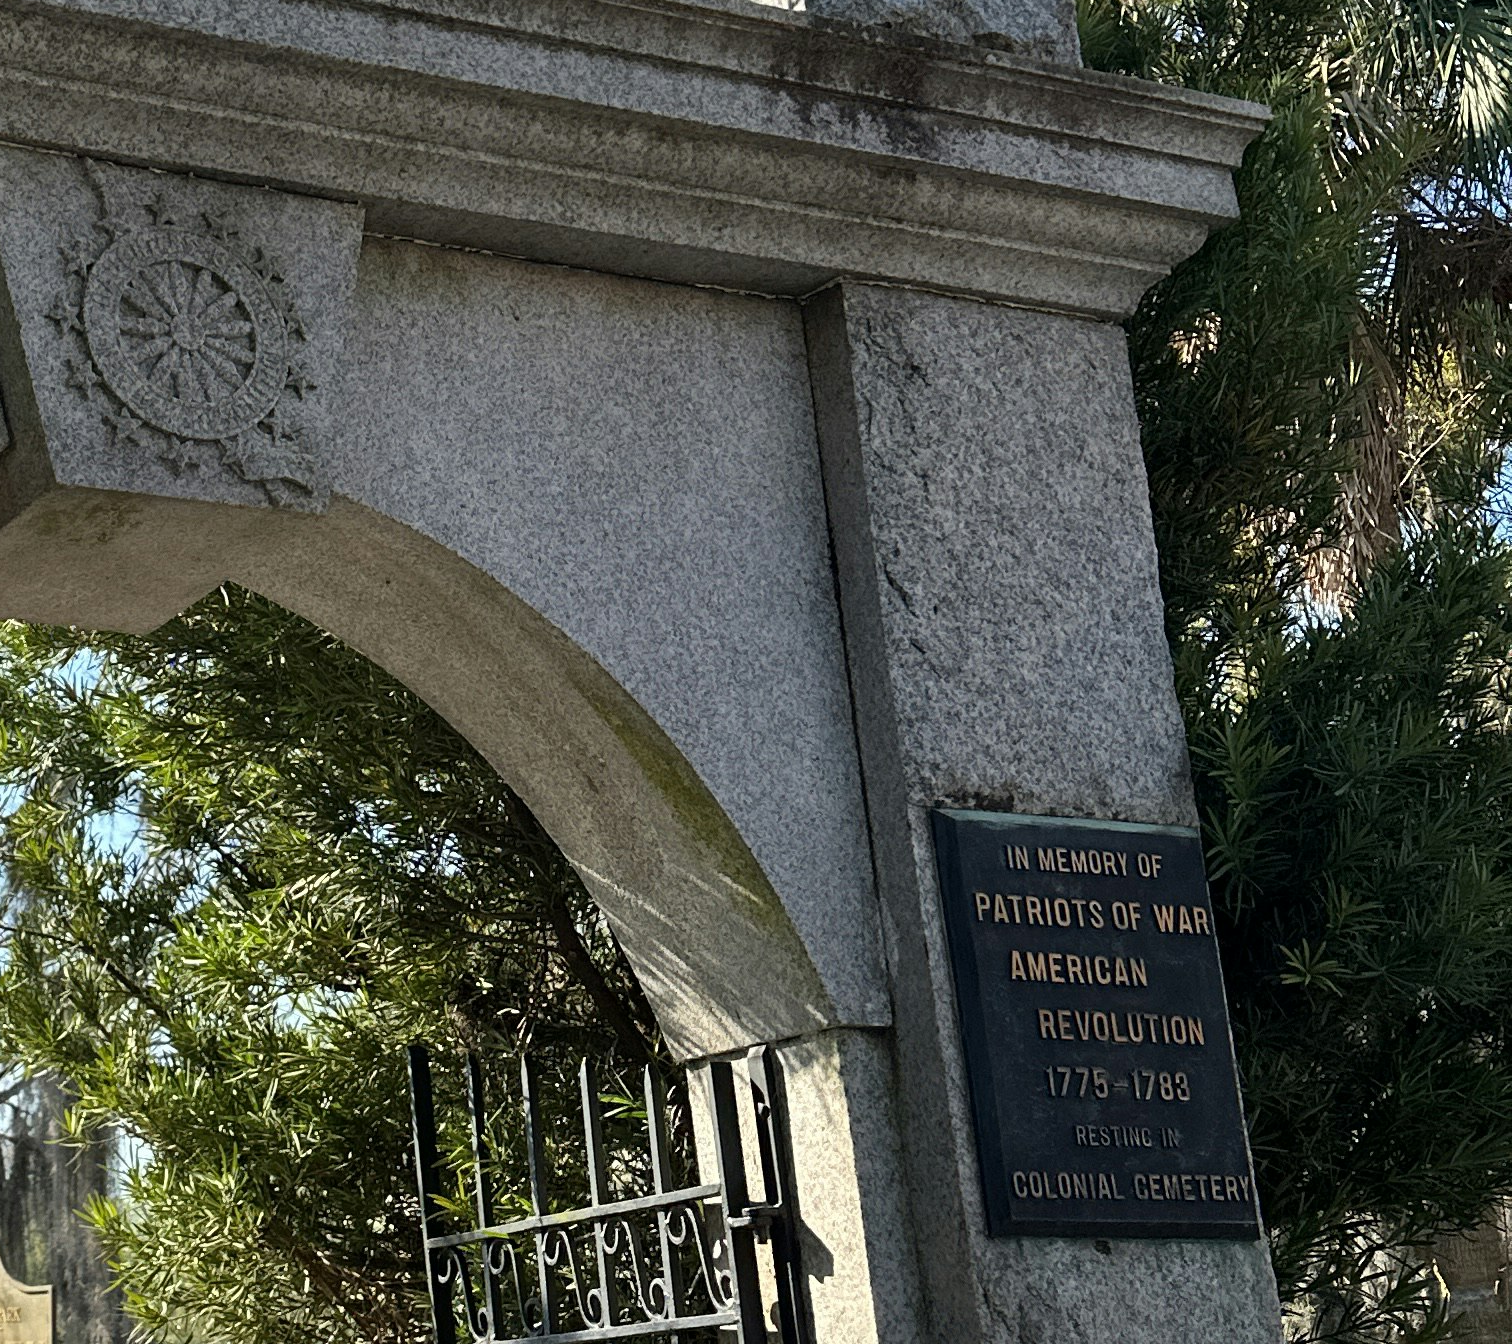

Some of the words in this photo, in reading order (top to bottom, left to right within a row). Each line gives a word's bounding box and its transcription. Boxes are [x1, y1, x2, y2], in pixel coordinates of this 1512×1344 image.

[1005, 843, 1031, 871] IN
[1038, 847, 1129, 878] MEMORY
[1137, 852, 1163, 880] OF
[974, 891, 1105, 931] PATRIOTS
[1111, 901, 1143, 932] OF
[1151, 902, 1212, 937] WAR
[1009, 949, 1149, 988] AMERICAN
[1038, 1007, 1206, 1046] REVOLUTION
[1075, 1124, 1153, 1149] RESTING
[1161, 1126, 1181, 1149] IN
[1011, 1169, 1126, 1202] COLONIAL
[1134, 1172, 1252, 1203] CEMETERY
